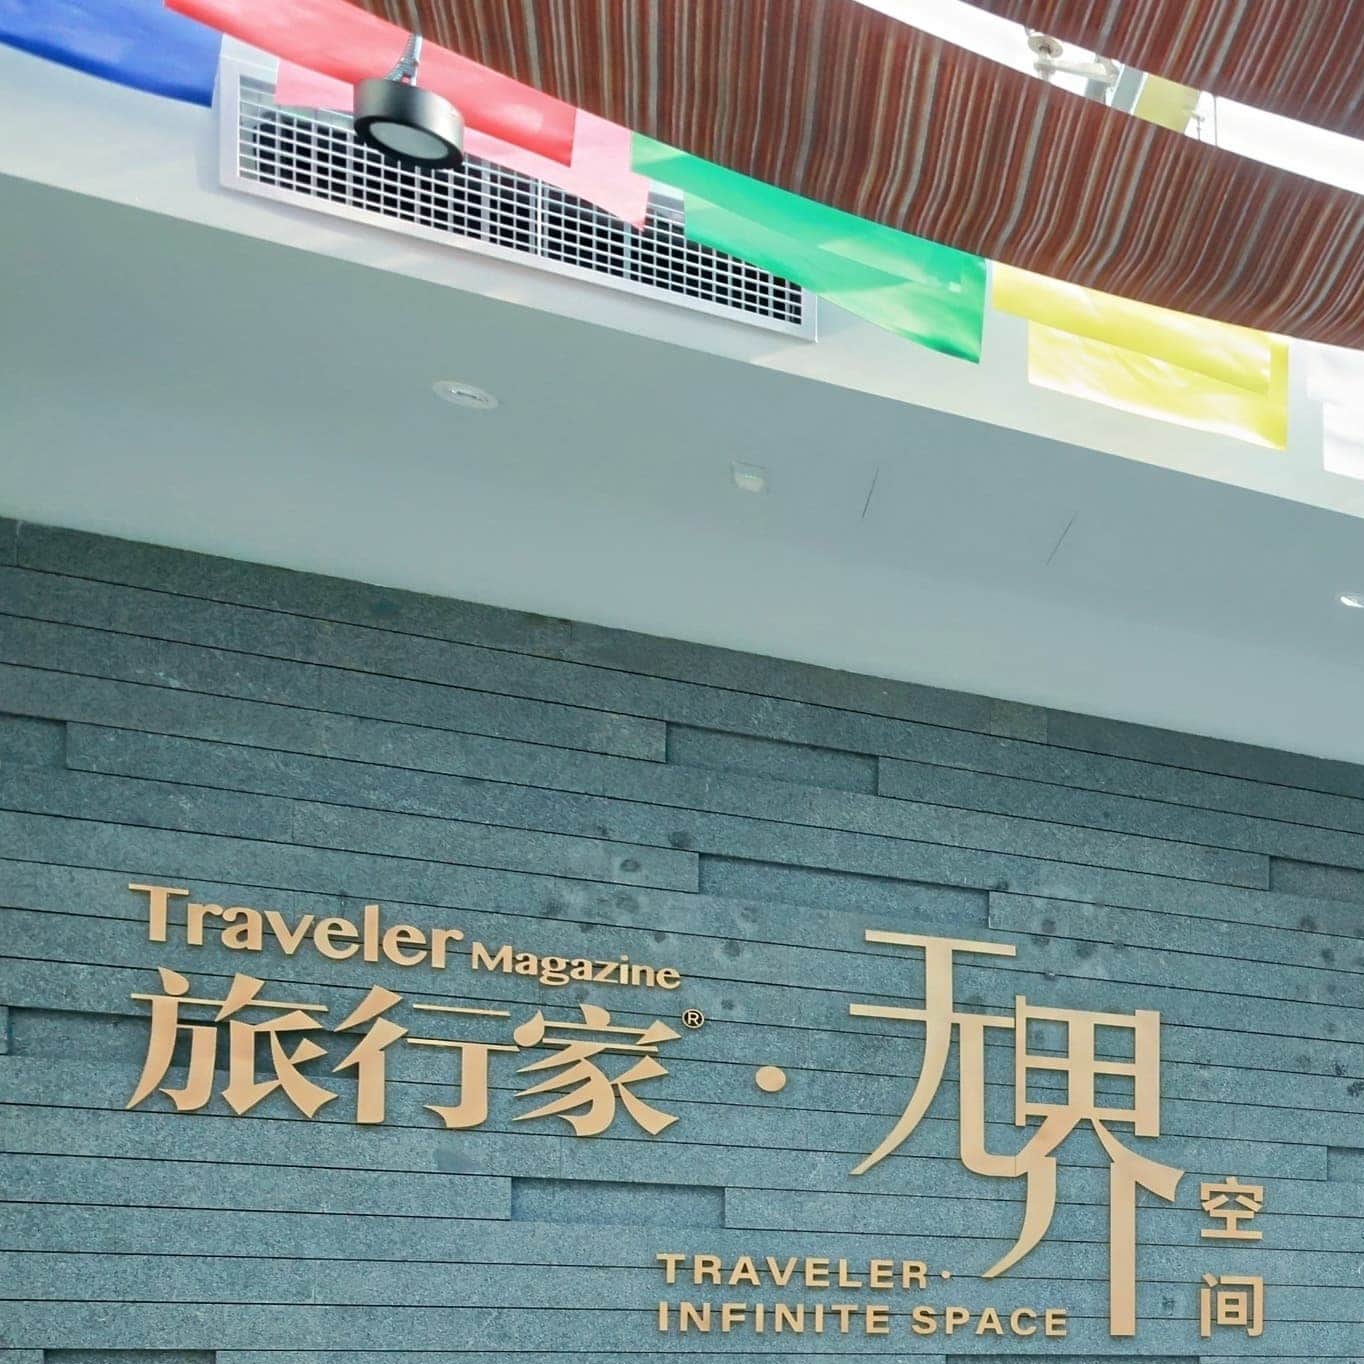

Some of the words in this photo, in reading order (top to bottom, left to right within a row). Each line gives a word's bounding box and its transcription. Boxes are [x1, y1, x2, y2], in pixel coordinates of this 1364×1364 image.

[128, 883, 464, 969] Traveler
[471, 944, 682, 989] Magazine
[126, 966, 682, 1136] 旅行家
[849, 929, 1185, 1337] 无界
[657, 1301, 891, 1336] INFINITE
[911, 1306, 1068, 1337] SPACE
[1200, 1177, 1264, 1338] 空间
